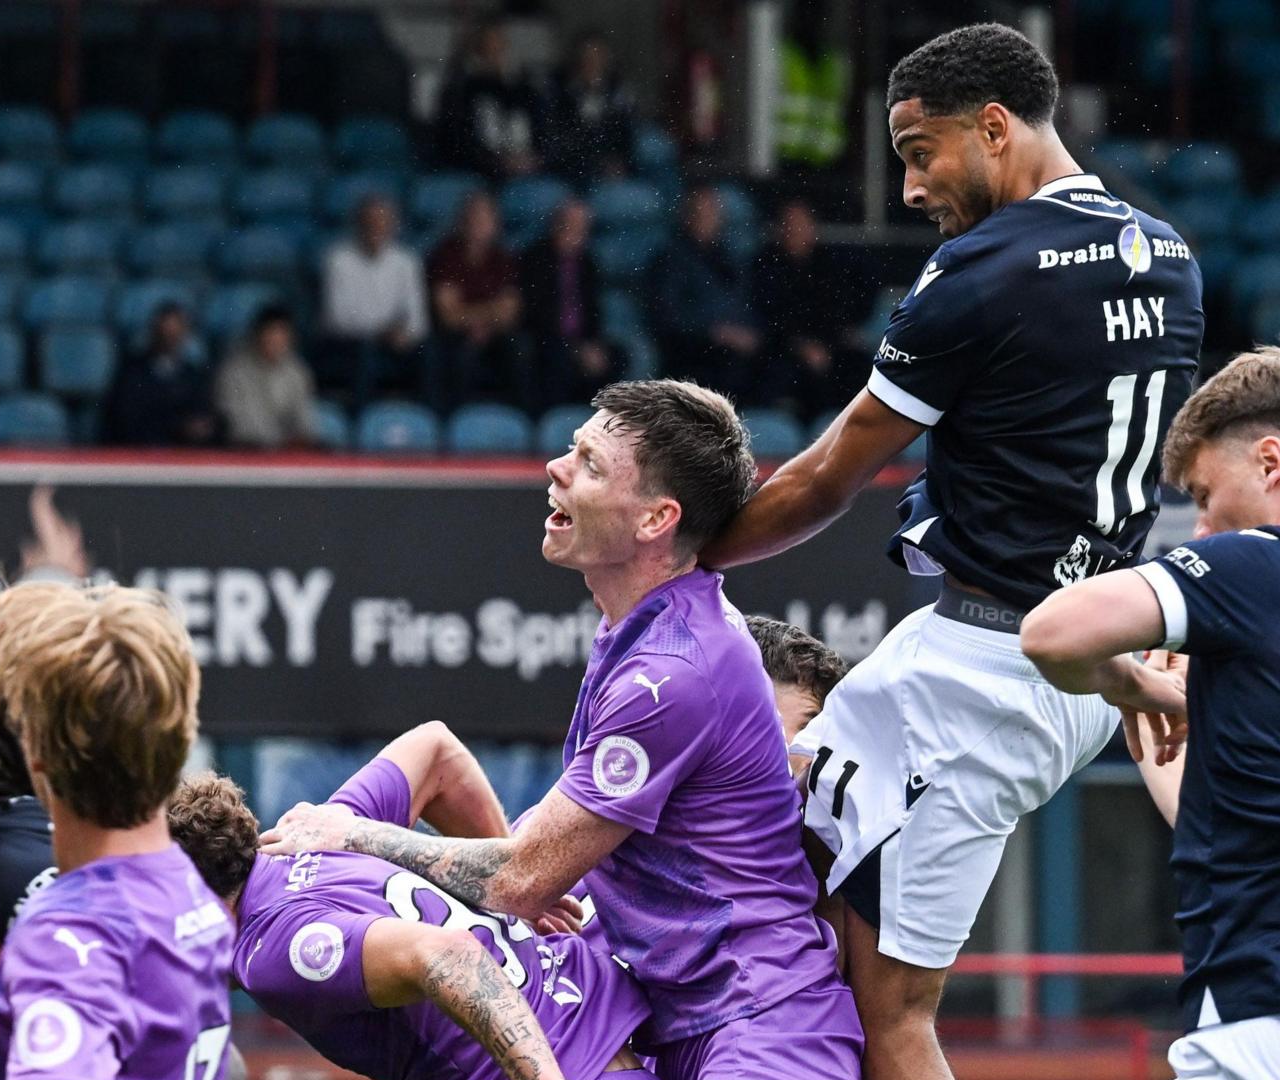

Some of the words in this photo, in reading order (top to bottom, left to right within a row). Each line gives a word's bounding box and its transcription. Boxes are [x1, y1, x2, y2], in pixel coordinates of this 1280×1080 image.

[1038, 243, 1116, 269] Drain
[1103, 296, 1166, 341] HAY
[1087, 369, 1167, 537] 11
[350, 599, 472, 669] Fire
[959, 600, 1021, 625] mac
[808, 745, 860, 820] 11
